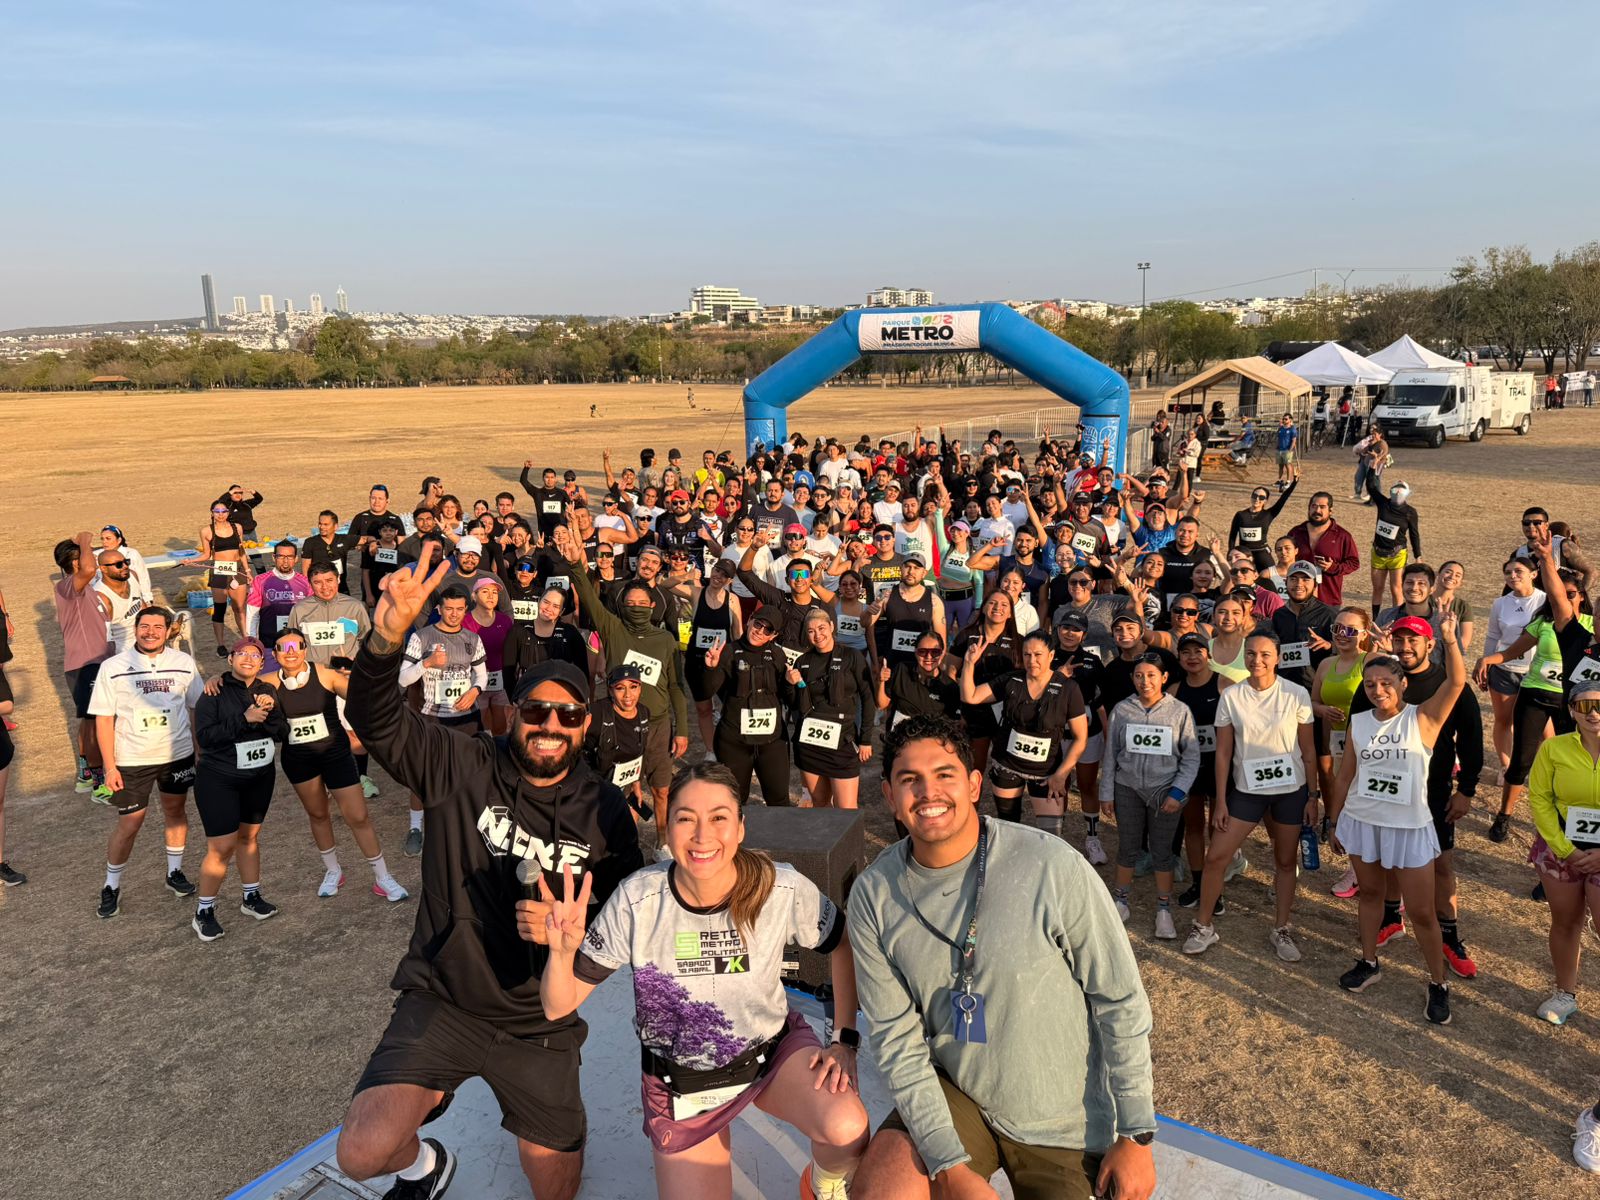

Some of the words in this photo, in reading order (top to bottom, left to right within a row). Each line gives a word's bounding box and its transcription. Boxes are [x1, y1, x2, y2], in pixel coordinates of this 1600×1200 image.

[881, 325, 954, 341] METRO
[759, 516, 783, 525] MICHELIN
[1076, 538, 1091, 548] 390
[948, 558, 964, 567] 203
[1293, 562, 1310, 570] FILA
[840, 621, 858, 631] 223
[315, 630, 336, 641] 336
[898, 637, 916, 647] 242
[1282, 650, 1302, 662] 082
[445, 688, 462, 697] 011
[748, 718, 770, 729] 274
[294, 725, 316, 738] 251
[807, 727, 831, 741] 296
[1133, 734, 1162, 747] 062
[1370, 734, 1401, 745] YOU
[1014, 741, 1039, 756] 384
[1360, 749, 1392, 760] GOT
[1396, 748, 1409, 760] IT
[246, 748, 267, 762] 165
[1254, 766, 1284, 781] 356
[1367, 778, 1399, 795] 275
[700, 930, 740, 940] RETO
[700, 938, 741, 948] METRO
[700, 947, 748, 957] POLITANO
[722, 956, 745, 974] 7K
